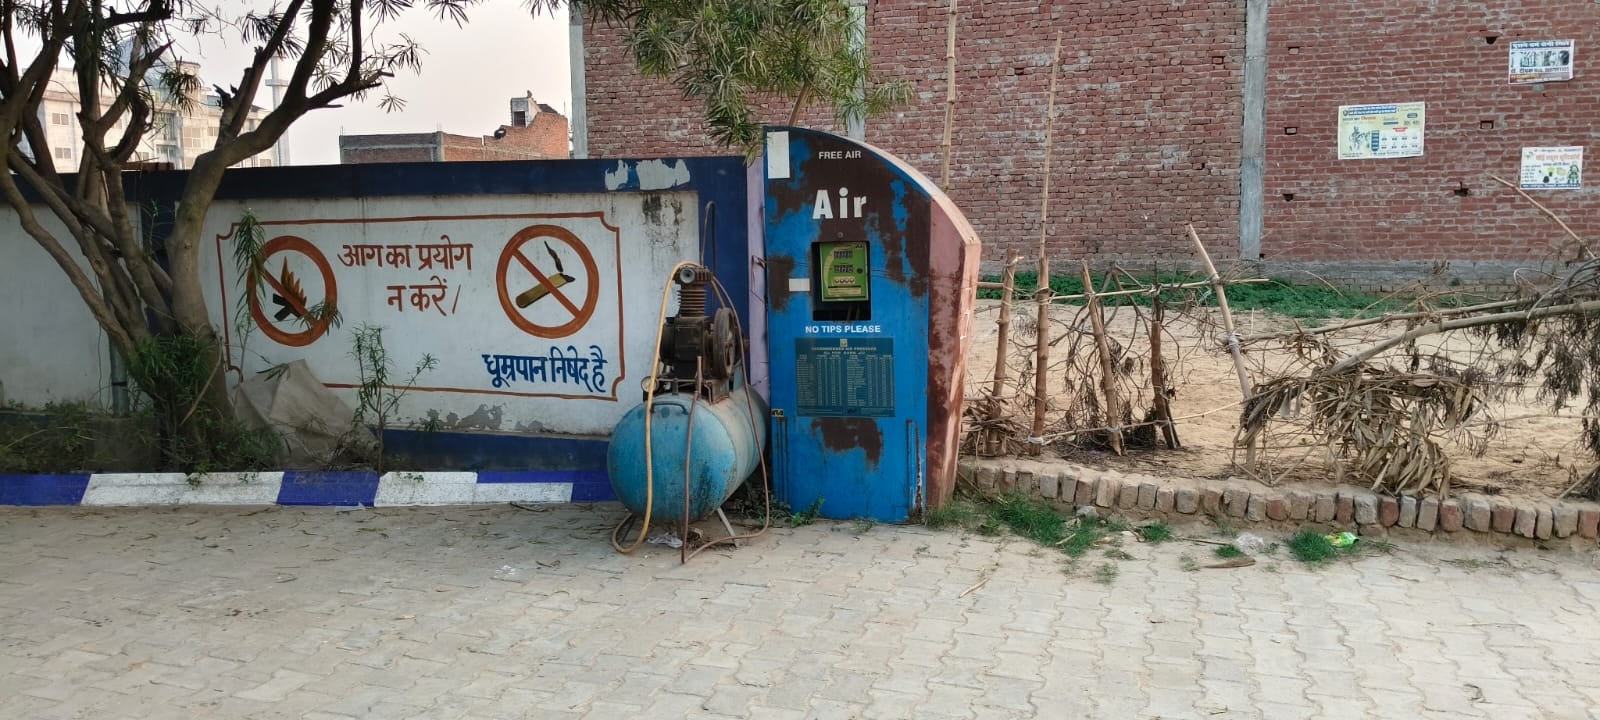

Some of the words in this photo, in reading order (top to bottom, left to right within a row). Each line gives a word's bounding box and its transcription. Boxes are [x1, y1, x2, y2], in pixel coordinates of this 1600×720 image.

[818, 151, 843, 160] FREE
[844, 150, 862, 159] AIR
[812, 186, 867, 220] Air
[337, 244, 383, 267] आग
[385, 244, 412, 269] का
[415, 234, 474, 271] प्रयोग
[386, 285, 407, 312] न
[805, 325, 819, 334] NO
[821, 325, 842, 334] TIPS
[844, 324, 881, 334] PLEASE
[481, 354, 548, 388] धूम्रपान
[589, 345, 608, 393] है
